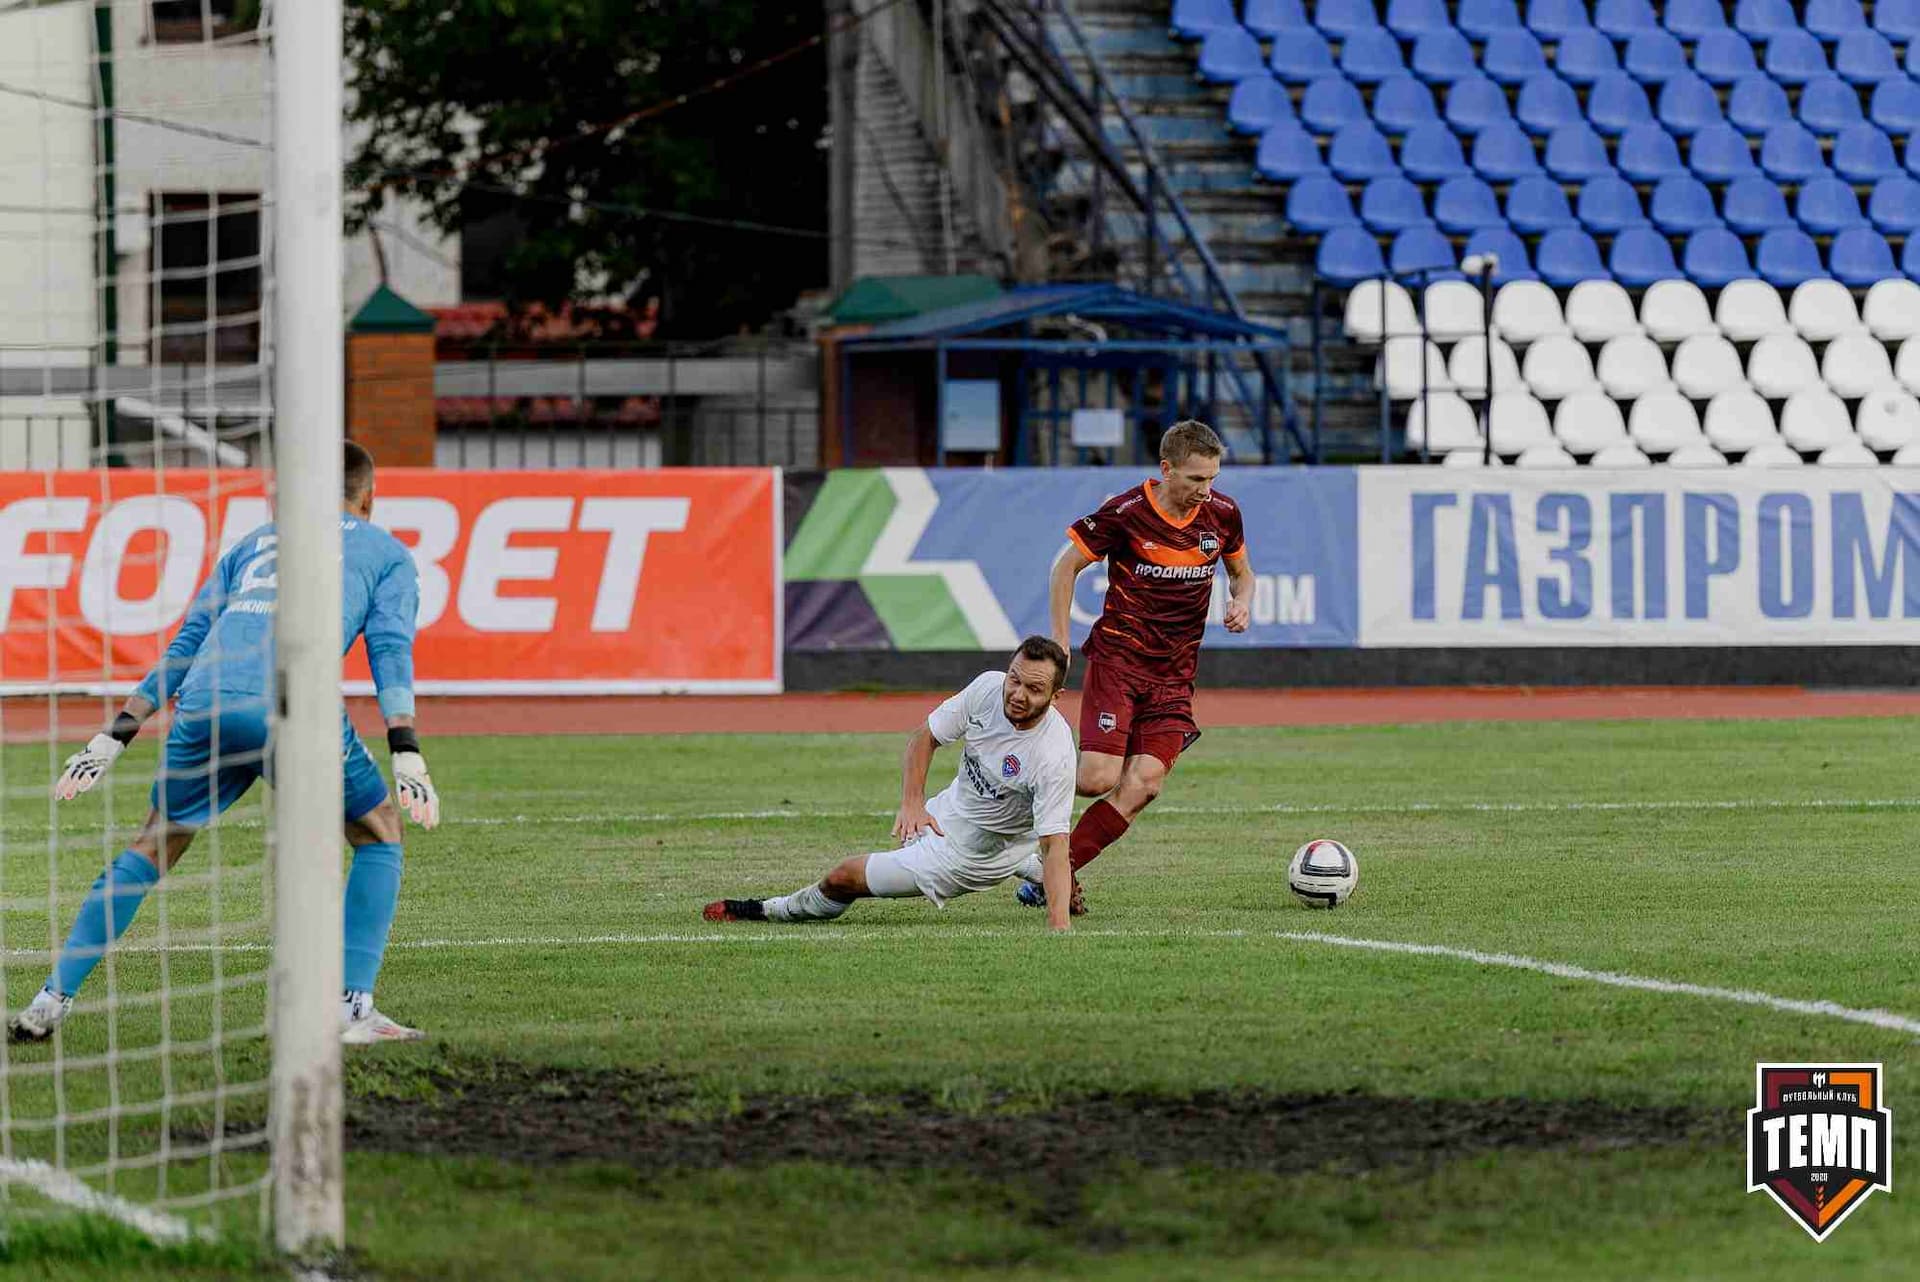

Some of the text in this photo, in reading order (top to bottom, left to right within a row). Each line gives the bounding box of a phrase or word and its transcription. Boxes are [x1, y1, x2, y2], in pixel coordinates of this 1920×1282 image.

[0, 494, 691, 635] FOBET
[1134, 563, 1216, 579] ПРОДИНВЕС
[1411, 492, 1920, 620] ГАЗПРОМ
